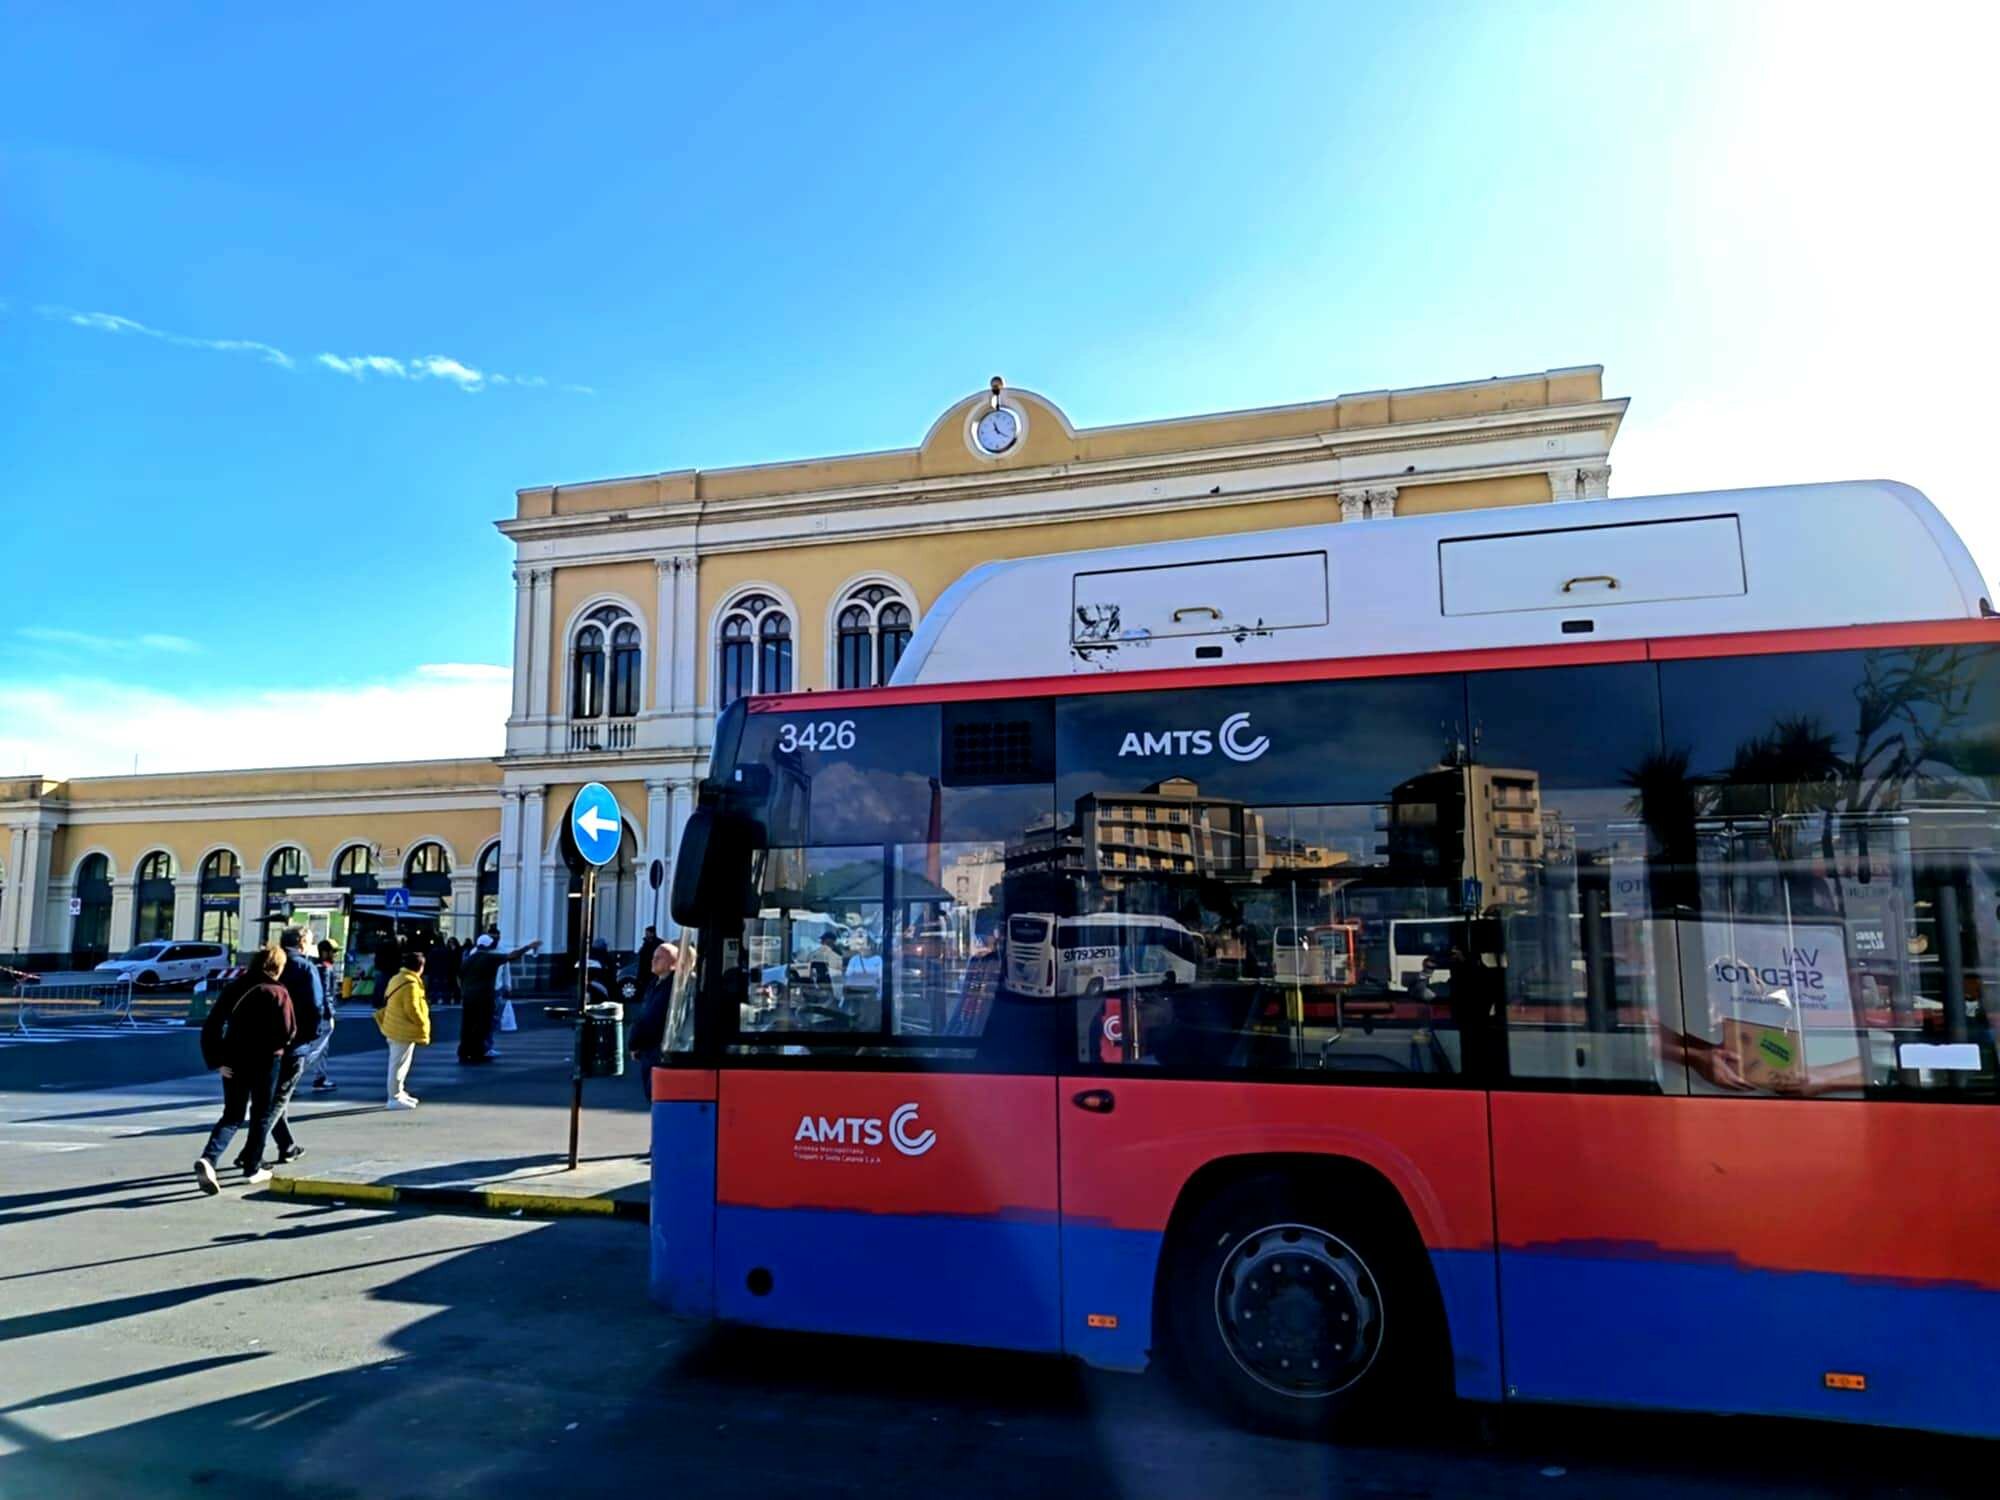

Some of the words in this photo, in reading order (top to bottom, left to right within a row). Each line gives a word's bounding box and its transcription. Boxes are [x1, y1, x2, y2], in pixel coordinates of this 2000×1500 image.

[779, 720, 856, 753] 3426
[1118, 730, 1213, 757] AMTS
[794, 1115, 884, 1146] AMTS
